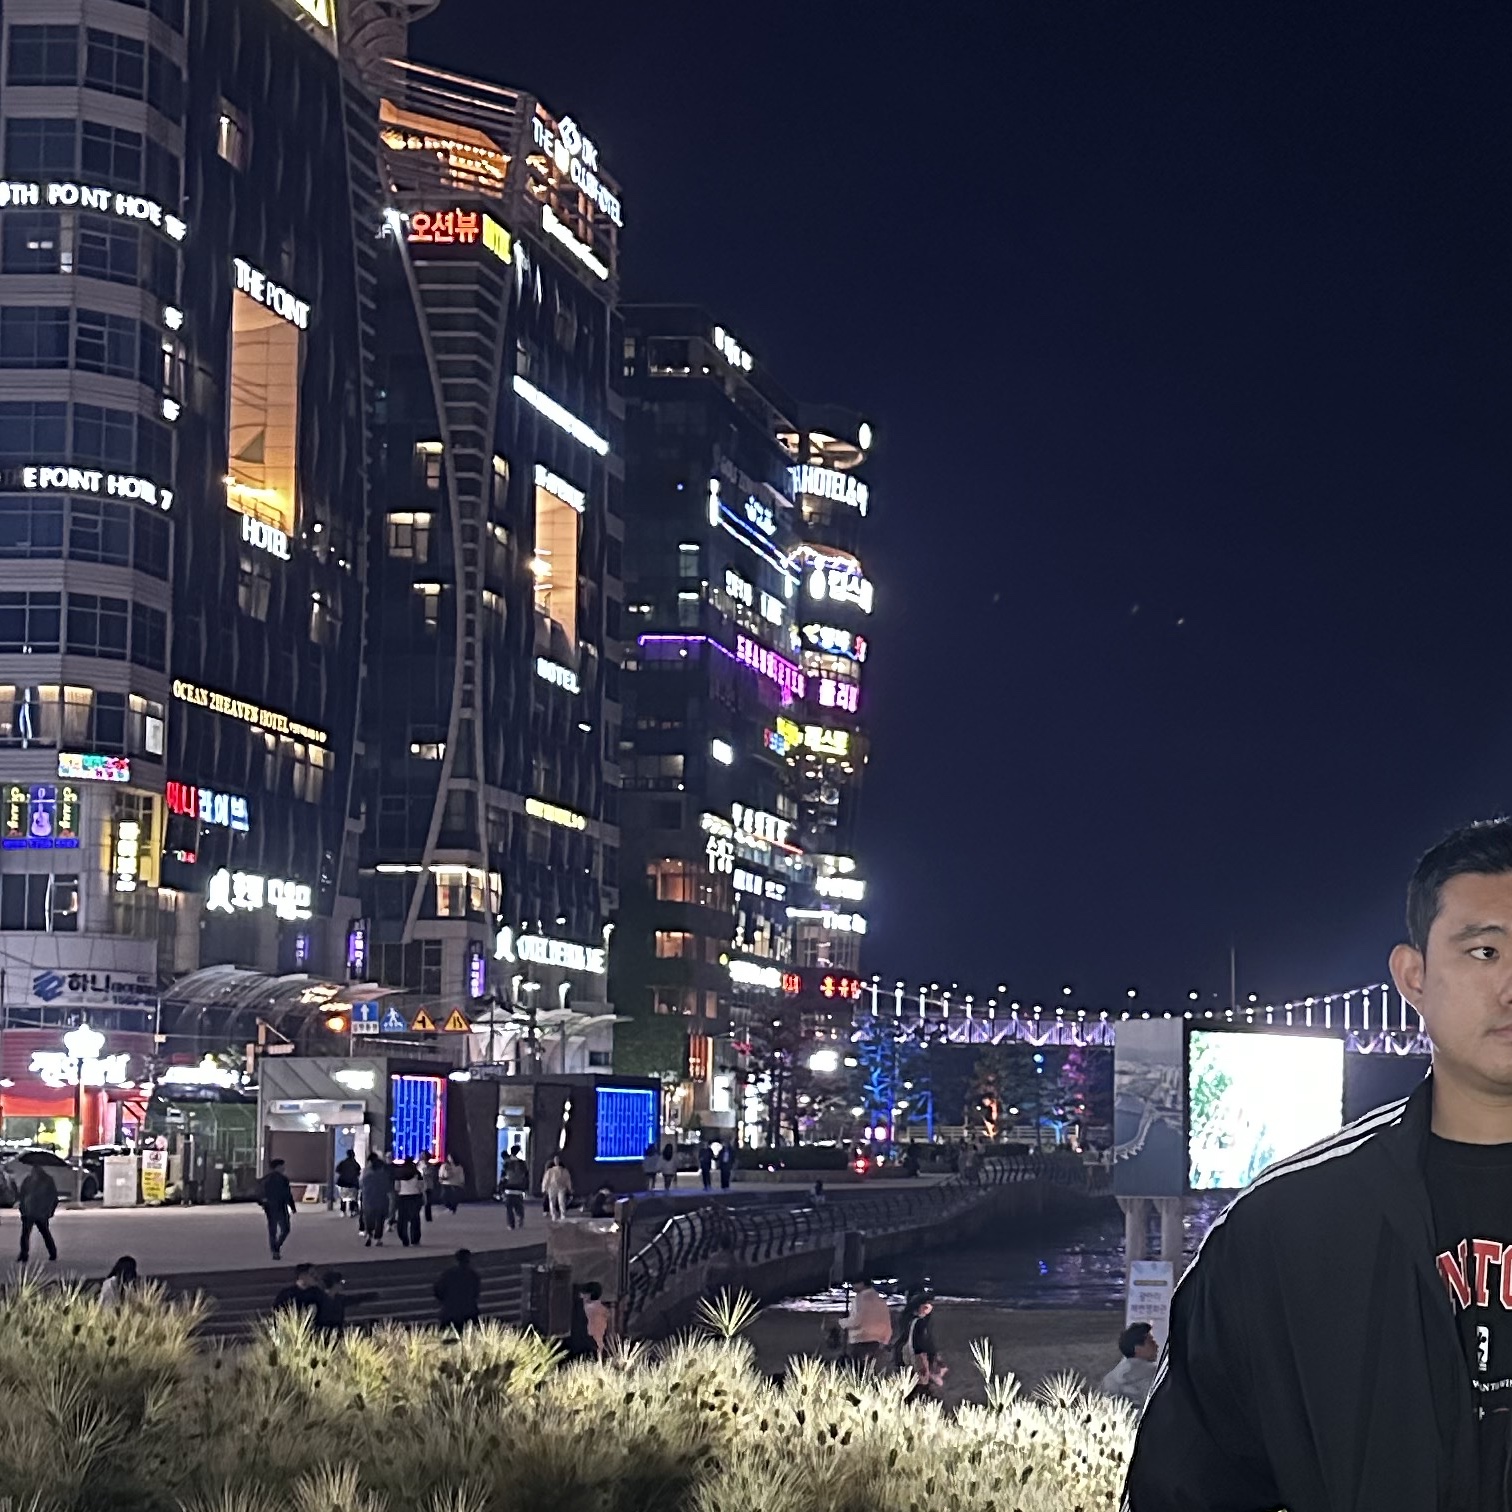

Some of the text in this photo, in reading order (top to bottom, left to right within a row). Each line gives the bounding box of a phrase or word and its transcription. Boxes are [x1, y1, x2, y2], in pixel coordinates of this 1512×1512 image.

[408, 210, 479, 244] 오션뷰
[233, 257, 266, 302] THE
[242, 513, 291, 560] HOTEL
[536, 656, 580, 694] HOTEL
[173, 679, 209, 706] OCEAN
[260, 709, 290, 734] HOTEL
[68, 972, 111, 994] 하니
